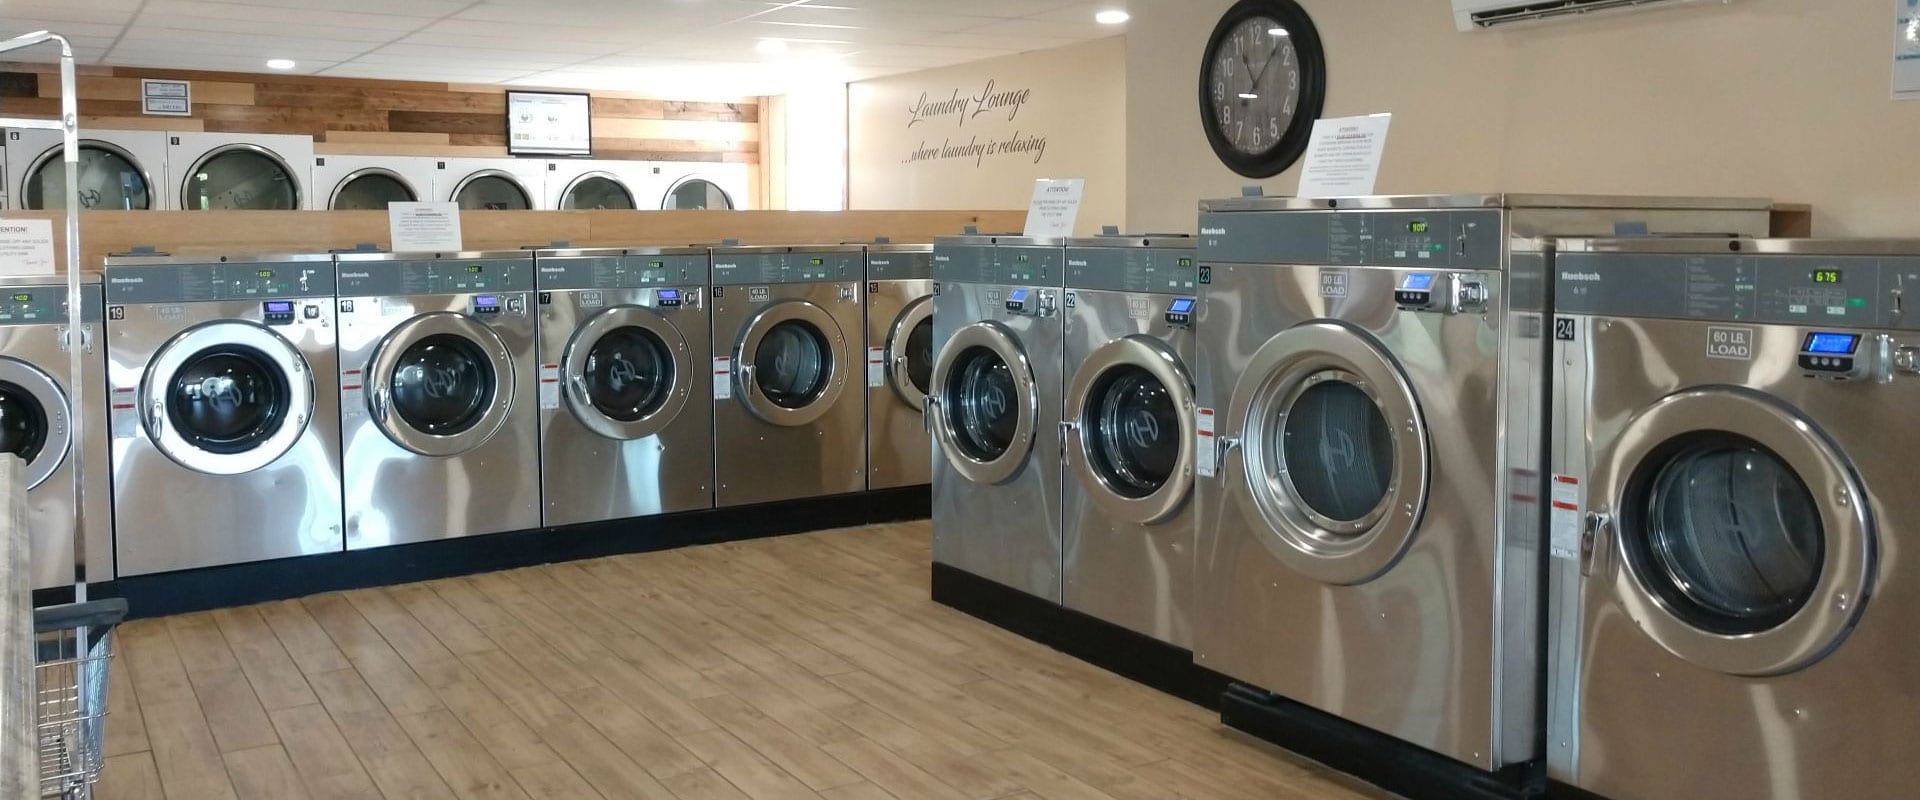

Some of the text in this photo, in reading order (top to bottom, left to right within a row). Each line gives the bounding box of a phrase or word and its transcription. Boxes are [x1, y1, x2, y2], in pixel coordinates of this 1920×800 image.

[1251, 25, 1261, 44] 12
[1235, 36, 1244, 55] 11
[1283, 48, 1290, 66] 2
[1223, 58, 1233, 76] 10
[1288, 71, 1296, 90] 3
[1218, 83, 1224, 100] 9
[908, 79, 1031, 128] Laundry Lounge
[1283, 98, 1290, 116] 4
[1224, 106, 1231, 124] 8
[1236, 121, 1243, 144] 7
[1253, 126, 1260, 145] 6
[1270, 117, 1278, 137] 5
[942, 136, 986, 168] laundry
[987, 140, 994, 155] is
[998, 131, 1047, 164] relaxing
[1200, 268, 1209, 282] 23
[1321, 286, 1345, 295] LOAD
[342, 301, 352, 311] 18
[1066, 294, 1075, 307] 22
[111, 308, 123, 319] 19
[1558, 320, 1573, 339] 24
[1714, 332, 1746, 344] 60 LB.
[1710, 344, 1747, 356] LOAD
